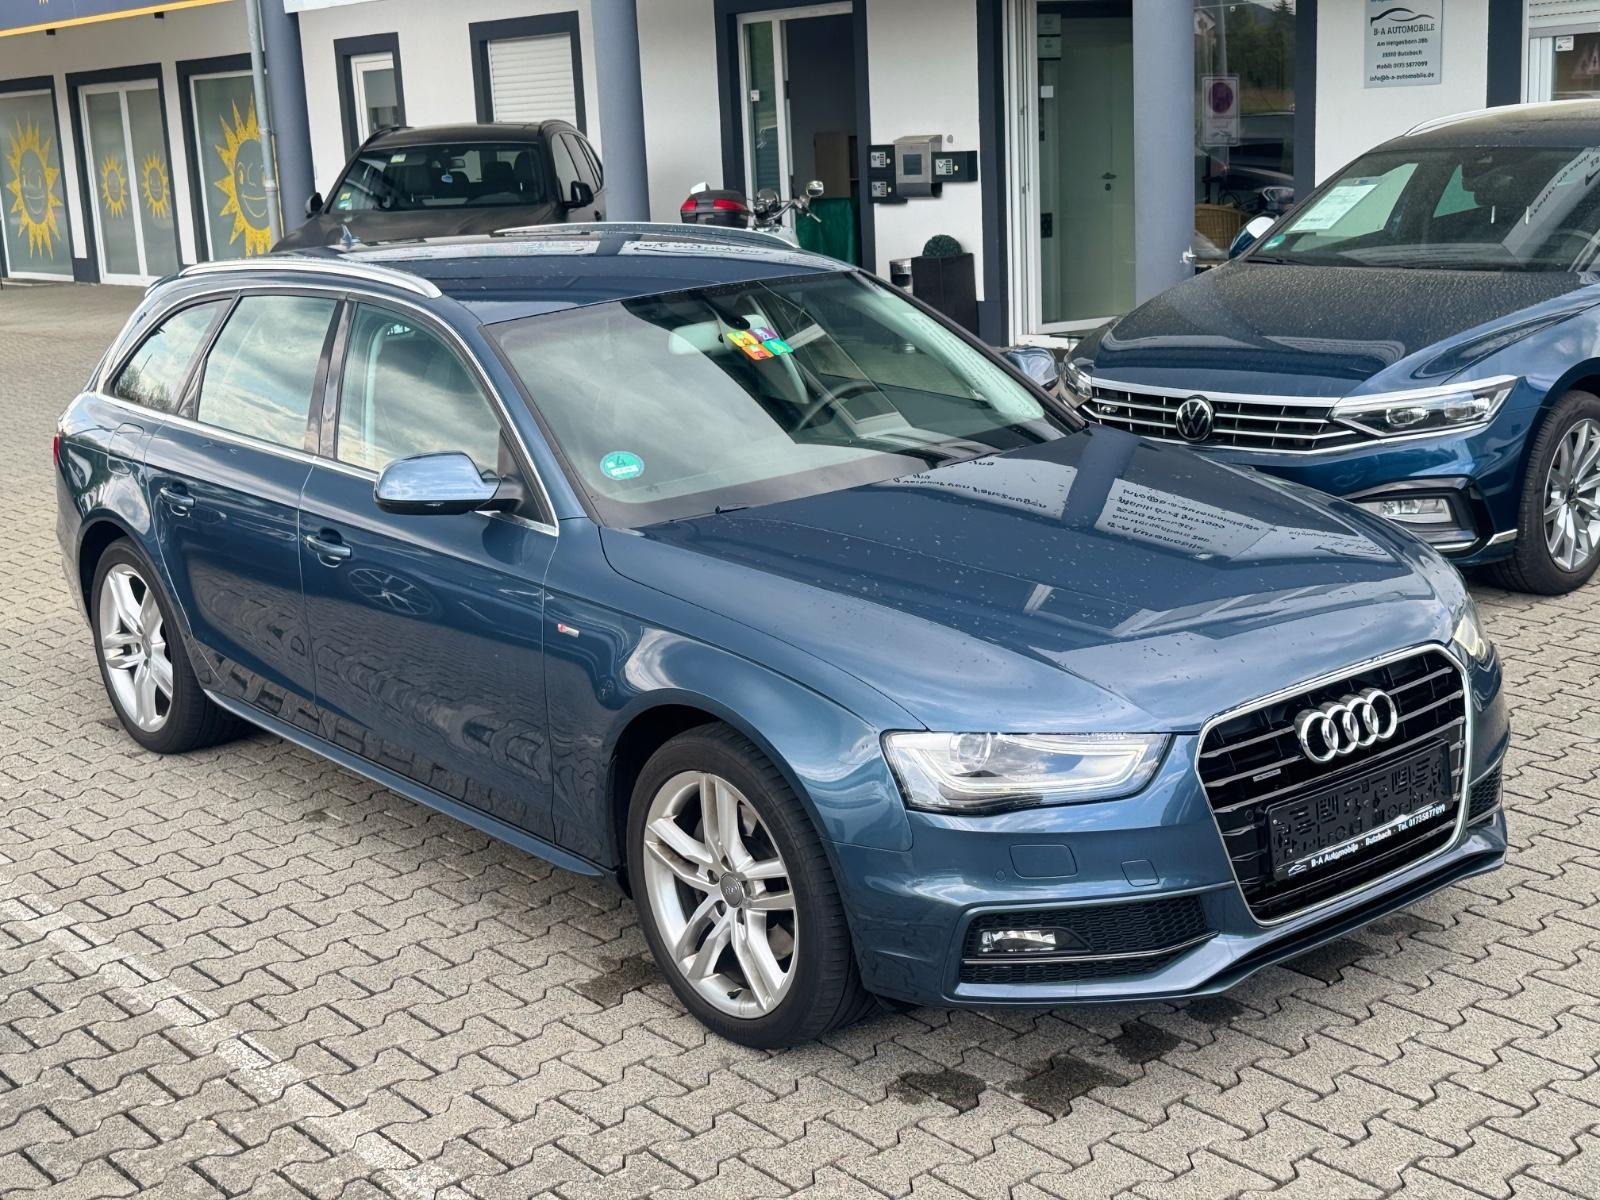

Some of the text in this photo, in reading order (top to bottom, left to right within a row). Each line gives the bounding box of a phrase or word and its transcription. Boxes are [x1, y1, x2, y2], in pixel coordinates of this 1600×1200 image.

[1373, 23, 1435, 36] B-A AUTOMOBILE
[1397, 49, 1423, 57] Butzbach
[1311, 856, 1323, 867] B-A
[1324, 843, 1359, 862] Automobile
[1365, 828, 1392, 846] Butzbach
